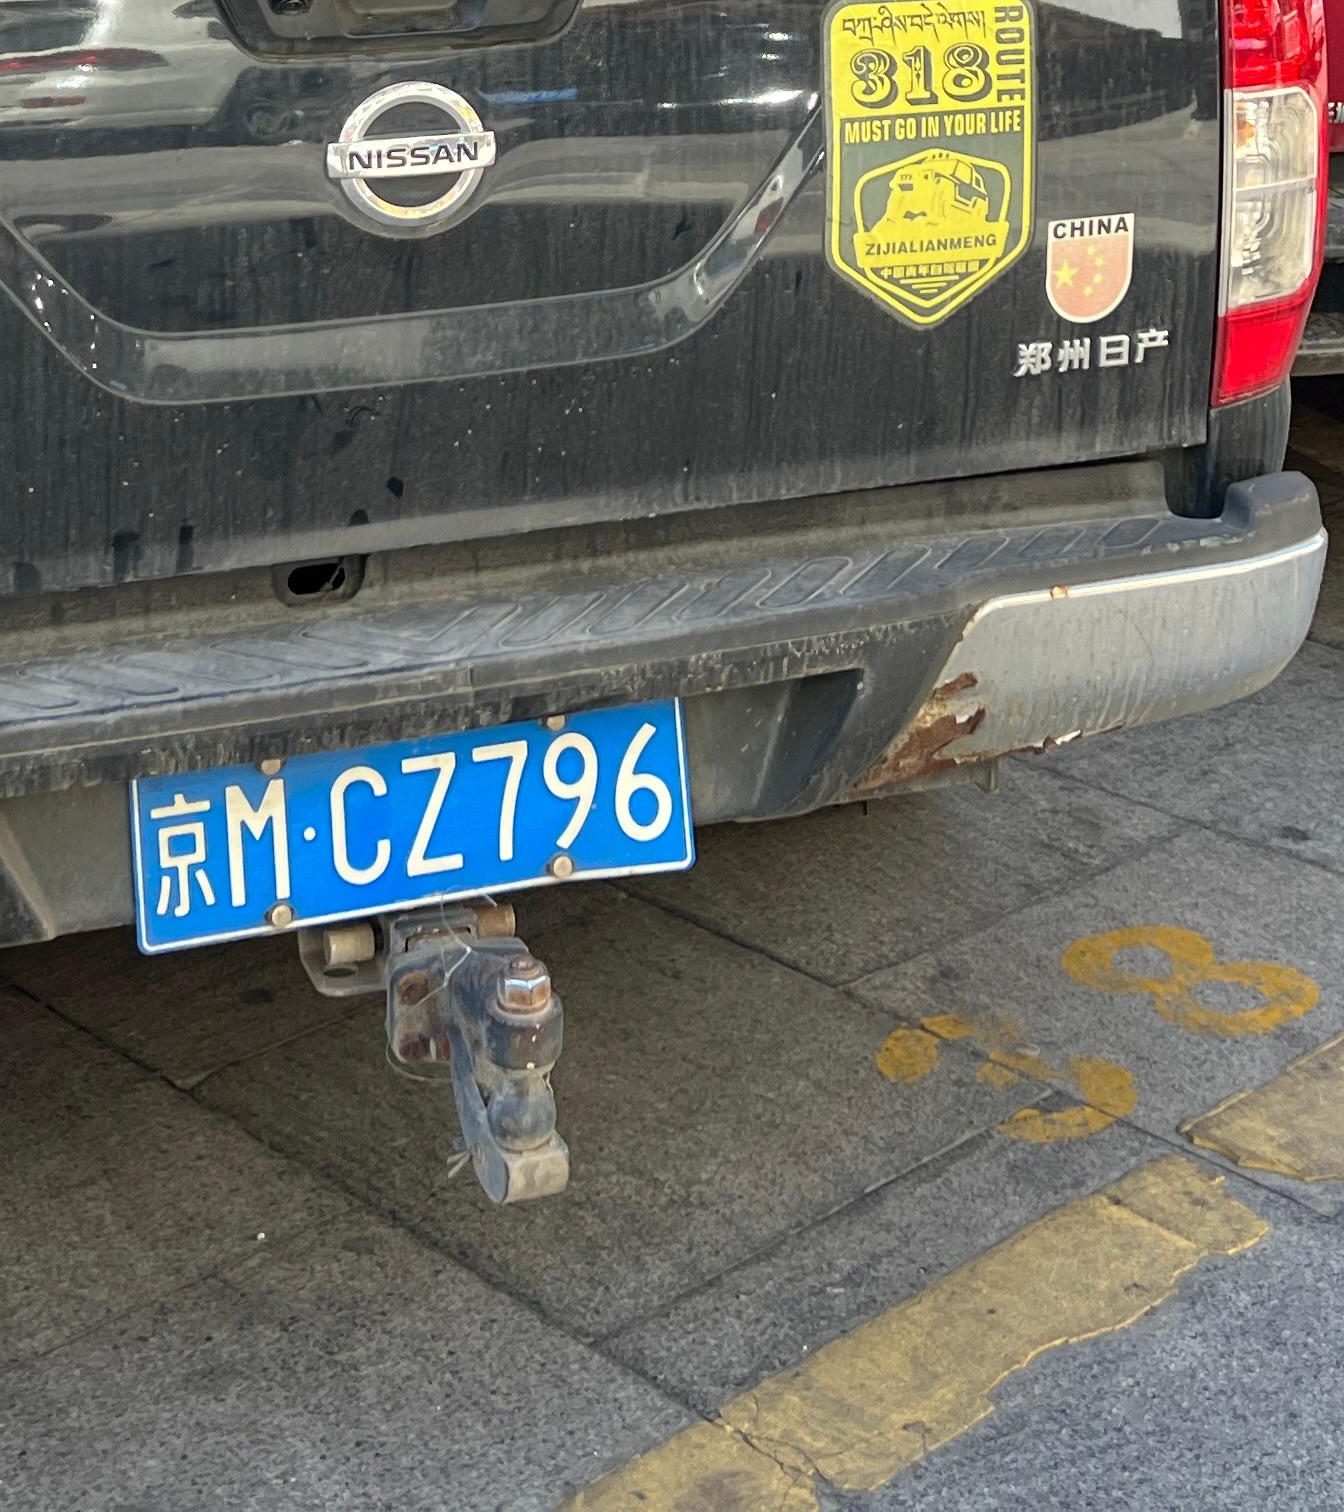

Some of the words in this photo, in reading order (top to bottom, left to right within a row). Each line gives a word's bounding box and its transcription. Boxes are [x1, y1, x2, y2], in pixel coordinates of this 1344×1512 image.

[994, 5, 1026, 104] ROUTE
[849, 42, 993, 110] 318
[844, 119, 892, 144] MUST
[894, 117, 917, 140] GO
[920, 115, 940, 138] IN
[943, 113, 987, 137] YOUR
[990, 110, 1022, 133] LIFE
[348, 141, 479, 172] NISSAN
[864, 233, 997, 256] ZIJIALIANMENG
[1052, 217, 1130, 240] CHINA
[1014, 328, 1170, 378] 郑州日产
